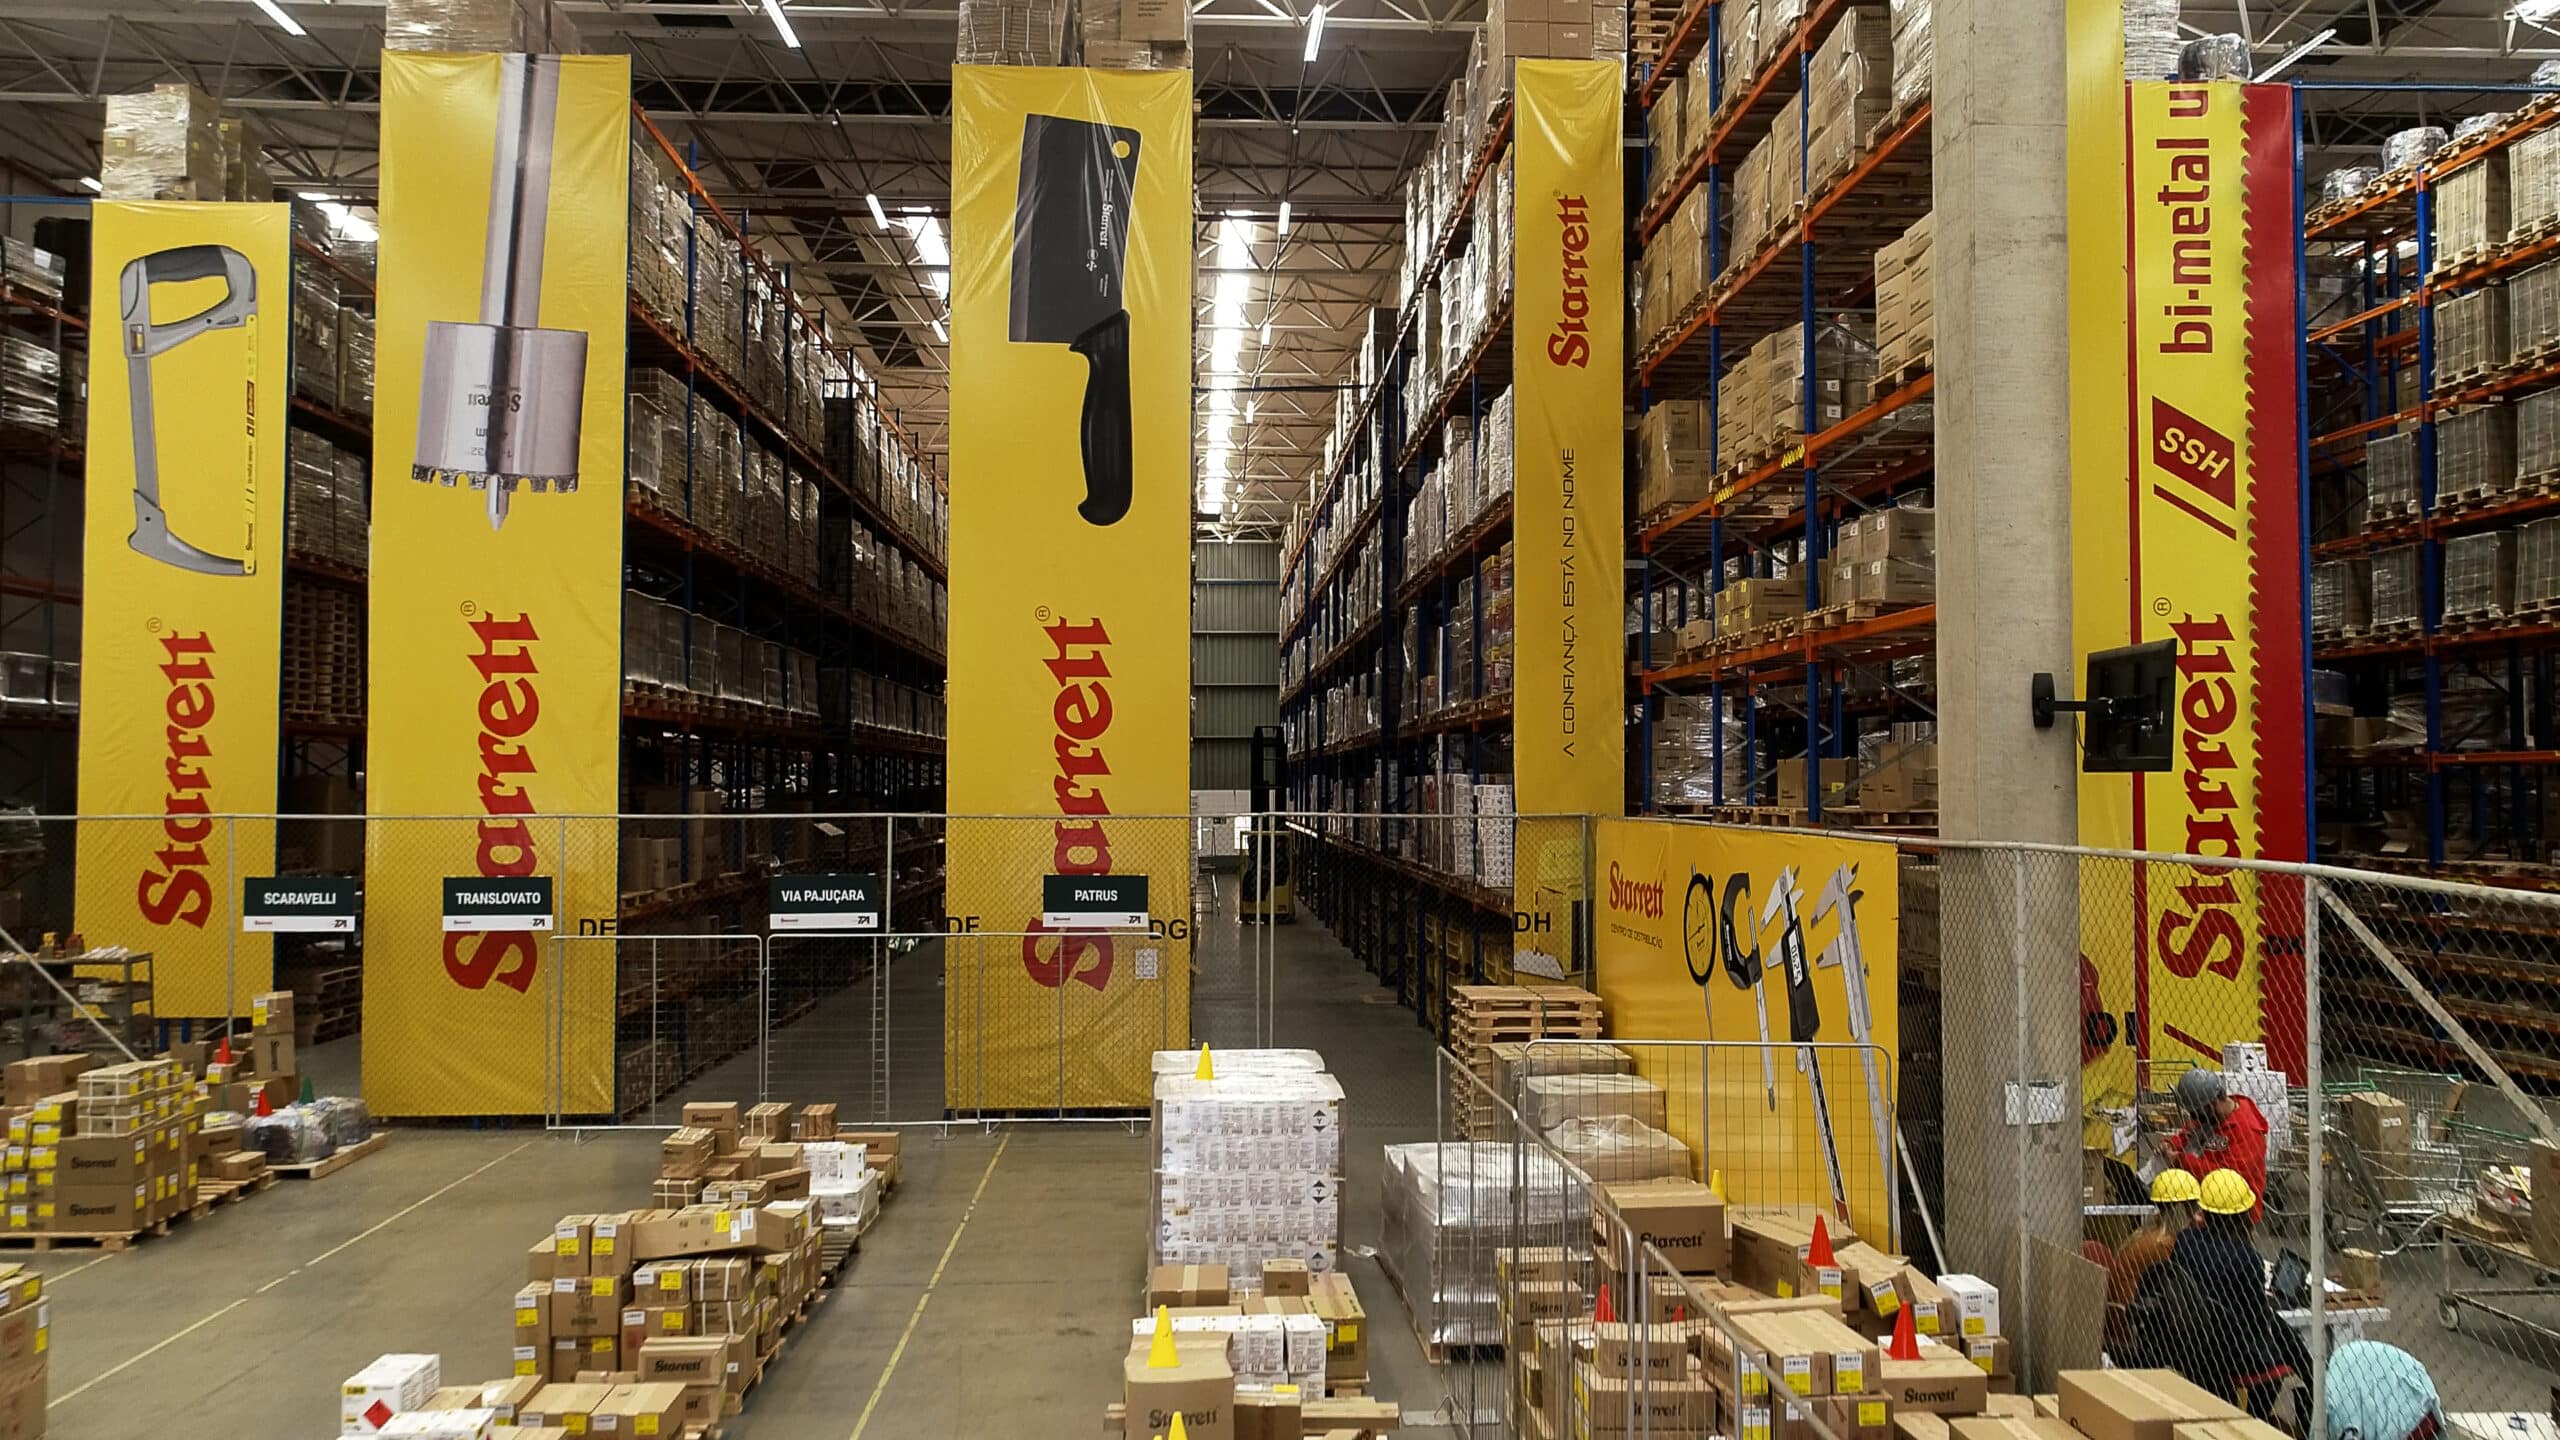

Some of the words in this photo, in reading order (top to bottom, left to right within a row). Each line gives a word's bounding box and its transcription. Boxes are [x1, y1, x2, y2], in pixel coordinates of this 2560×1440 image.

[2169, 80, 2209, 117] u
[2157, 138, 2213, 353] bi-metal
[1548, 195, 1590, 369] Starrett
[2160, 427, 2230, 478] SSH
[1562, 448, 1575, 509] NOME
[1562, 516, 1575, 547] NO
[1560, 555, 1575, 607] ESTÁ
[1562, 614, 1578, 735] CONFIANÇA
[1562, 741, 1575, 757] A
[138, 631, 215, 928] Starrett
[2158, 613, 2245, 982] Starrett
[264, 892, 337, 905] SCARAVELLI
[456, 892, 541, 905] TRANSLOVATO
[782, 890, 801, 902] VIA
[804, 890, 865, 904] PAJUÇARA
[1074, 890, 1118, 902] PATRUS
[1610, 861, 1664, 919] Starrett
[1149, 918, 1188, 941] DG
[1515, 911, 1551, 932] DH
[1640, 1232, 1703, 1248] Starrett
[1904, 1388, 1956, 1404] Starrett
